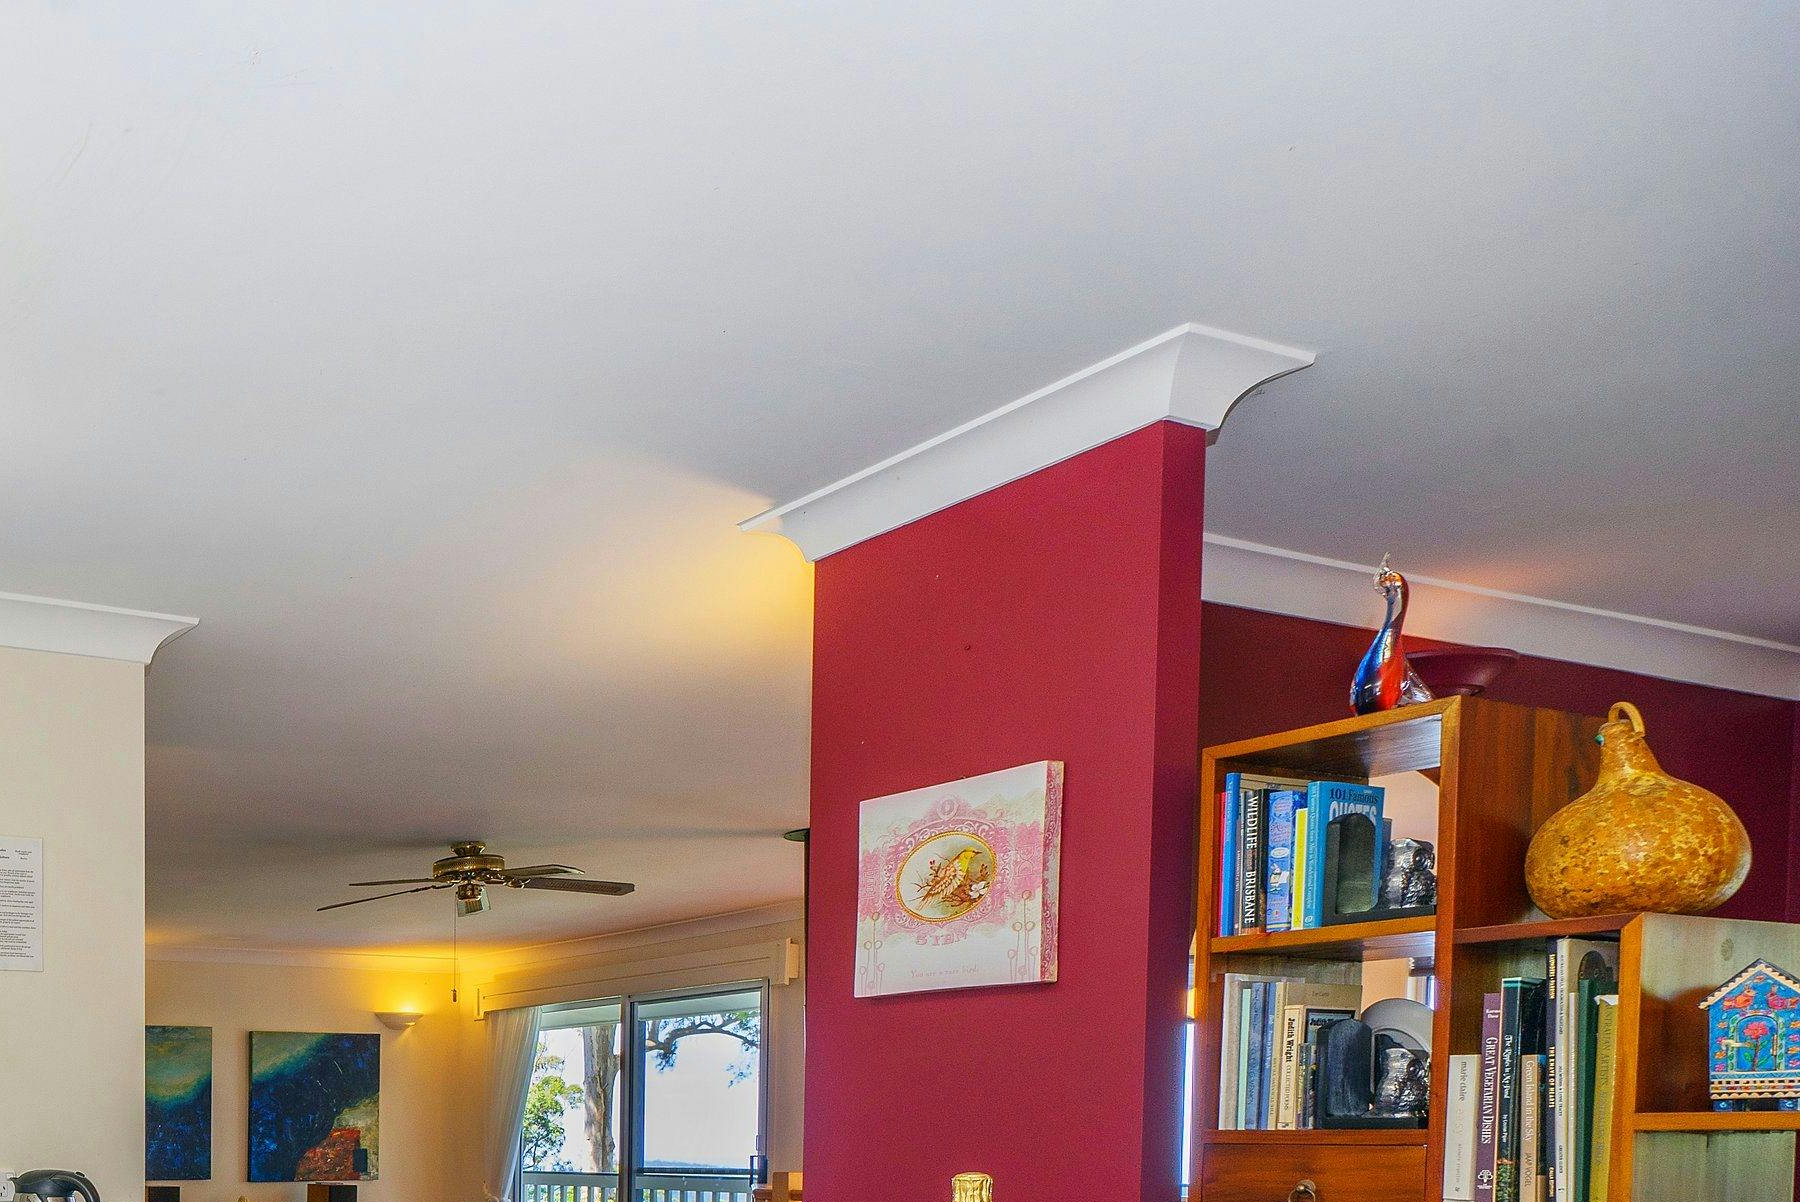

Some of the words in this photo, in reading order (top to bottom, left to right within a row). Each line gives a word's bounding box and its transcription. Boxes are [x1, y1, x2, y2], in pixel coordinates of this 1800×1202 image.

[1329, 787, 1347, 800] 101
[1348, 789, 1378, 804] Famous
[1245, 796, 1259, 849] WILDLIFE
[1242, 870, 1257, 924] BRISBANE
[1286, 1017, 1295, 1039] Judith
[1283, 1038, 1294, 1063] Wright
[1483, 1035, 1499, 1066] GREAT
[1503, 1033, 1513, 1047] The
[1459, 1060, 1468, 1082] marie
[1524, 1060, 1534, 1083] Green
[1598, 1053, 1610, 1086] ARTISTS
[1458, 1081, 1467, 1101] claire
[1480, 1065, 1497, 1115] VEGETARIAN
[1525, 1083, 1534, 1105] Island
[1525, 1106, 1533, 1115] in
[1525, 1115, 1533, 1127] the
[1480, 1114, 1494, 1145] DISHES
[1522, 1127, 1533, 1142] Sky
[1524, 1166, 1532, 1187] VOGEL
